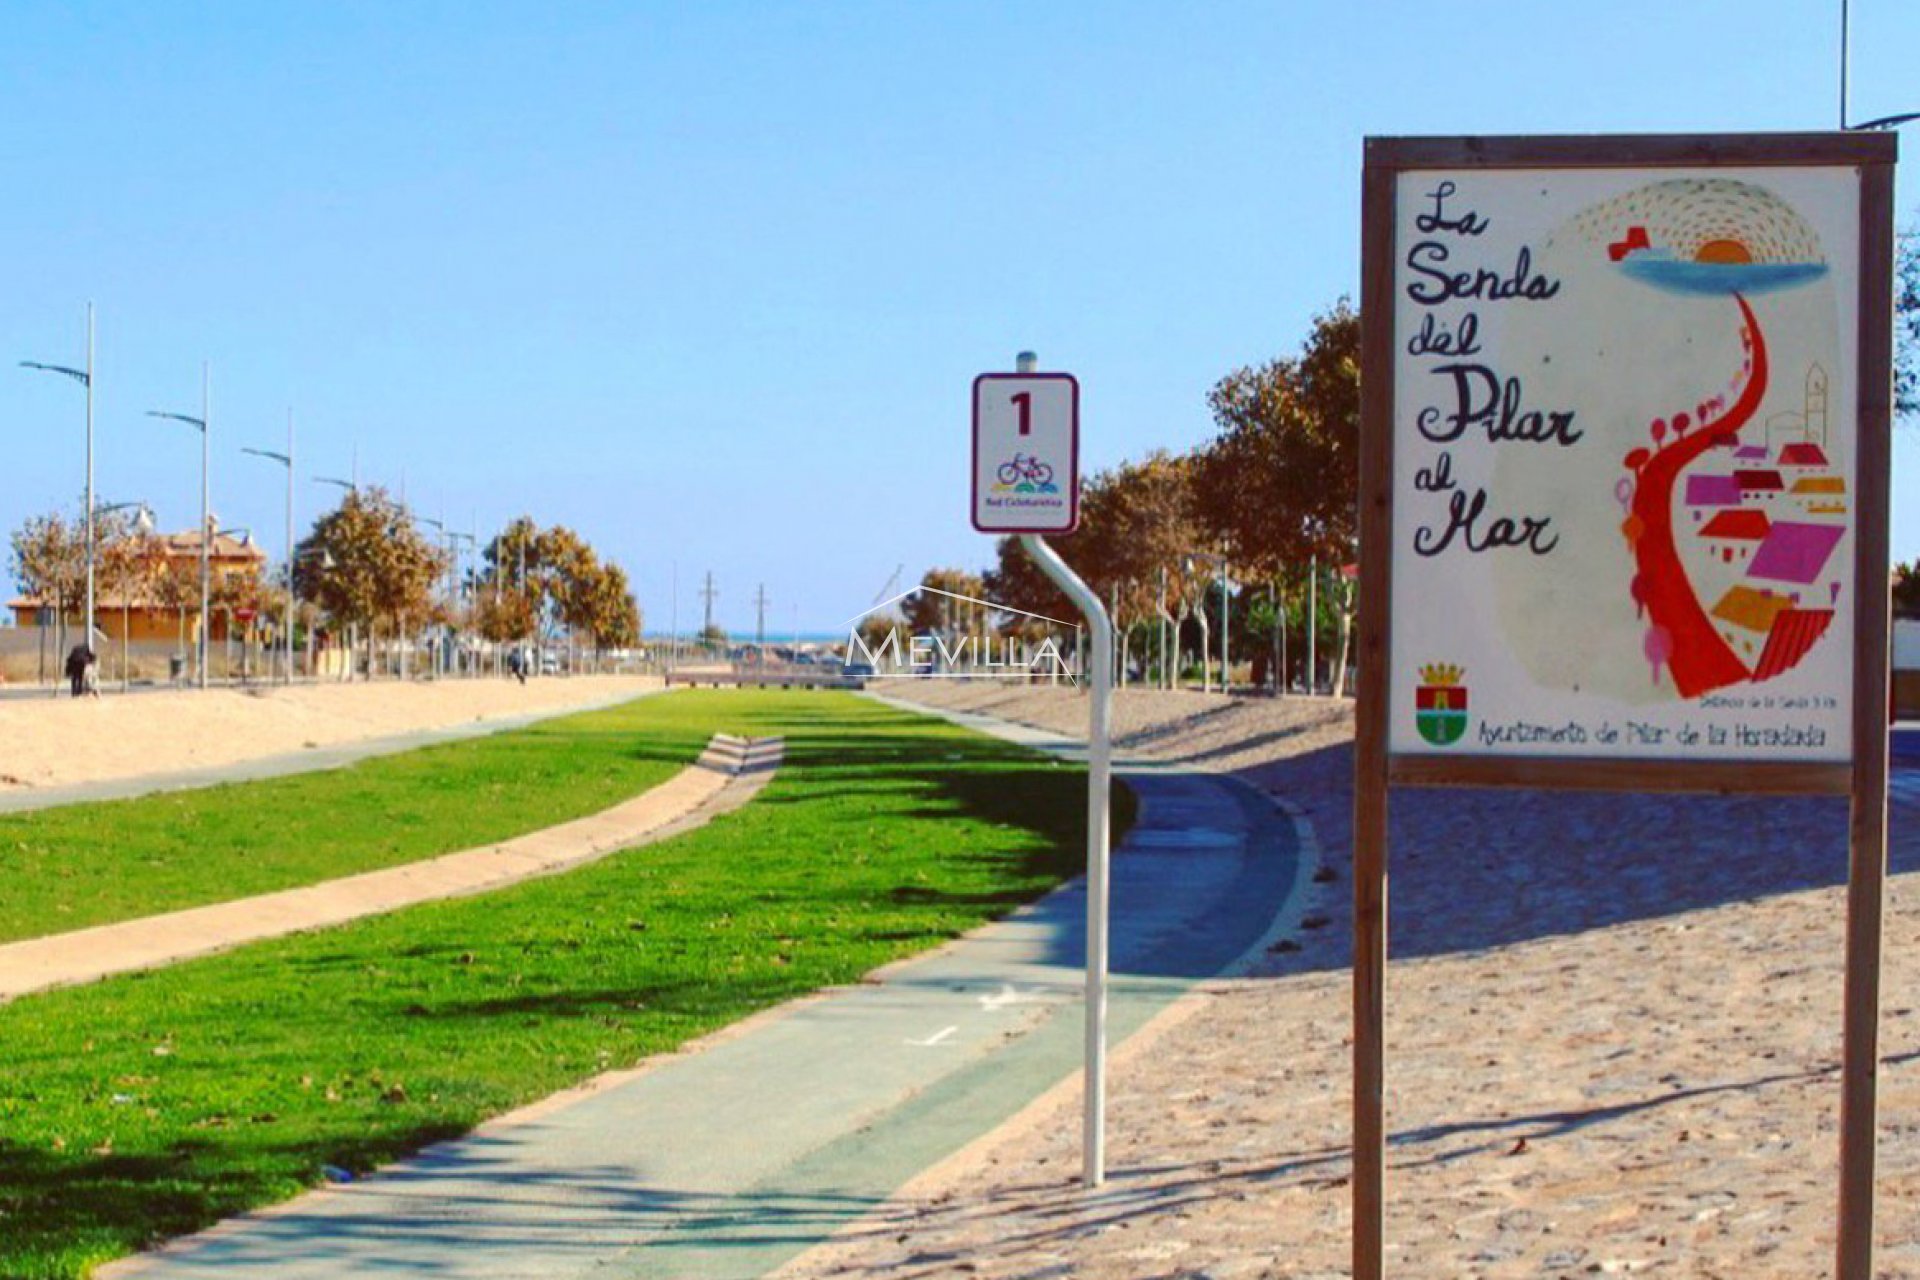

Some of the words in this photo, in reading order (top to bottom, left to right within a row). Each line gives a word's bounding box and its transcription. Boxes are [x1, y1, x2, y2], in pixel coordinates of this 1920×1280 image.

[1415, 181, 1489, 234] La
[1407, 242, 1560, 304] Senda
[1408, 312, 1482, 357] del
[1010, 391, 1031, 436] 1
[1417, 364, 1583, 445] Pilar
[1415, 453, 1457, 492] al
[1414, 488, 1560, 557] Mar
[1594, 721, 1619, 744] de
[1626, 720, 1670, 745] Pilar
[1676, 722, 1700, 745] de
[1707, 722, 1728, 745] la
